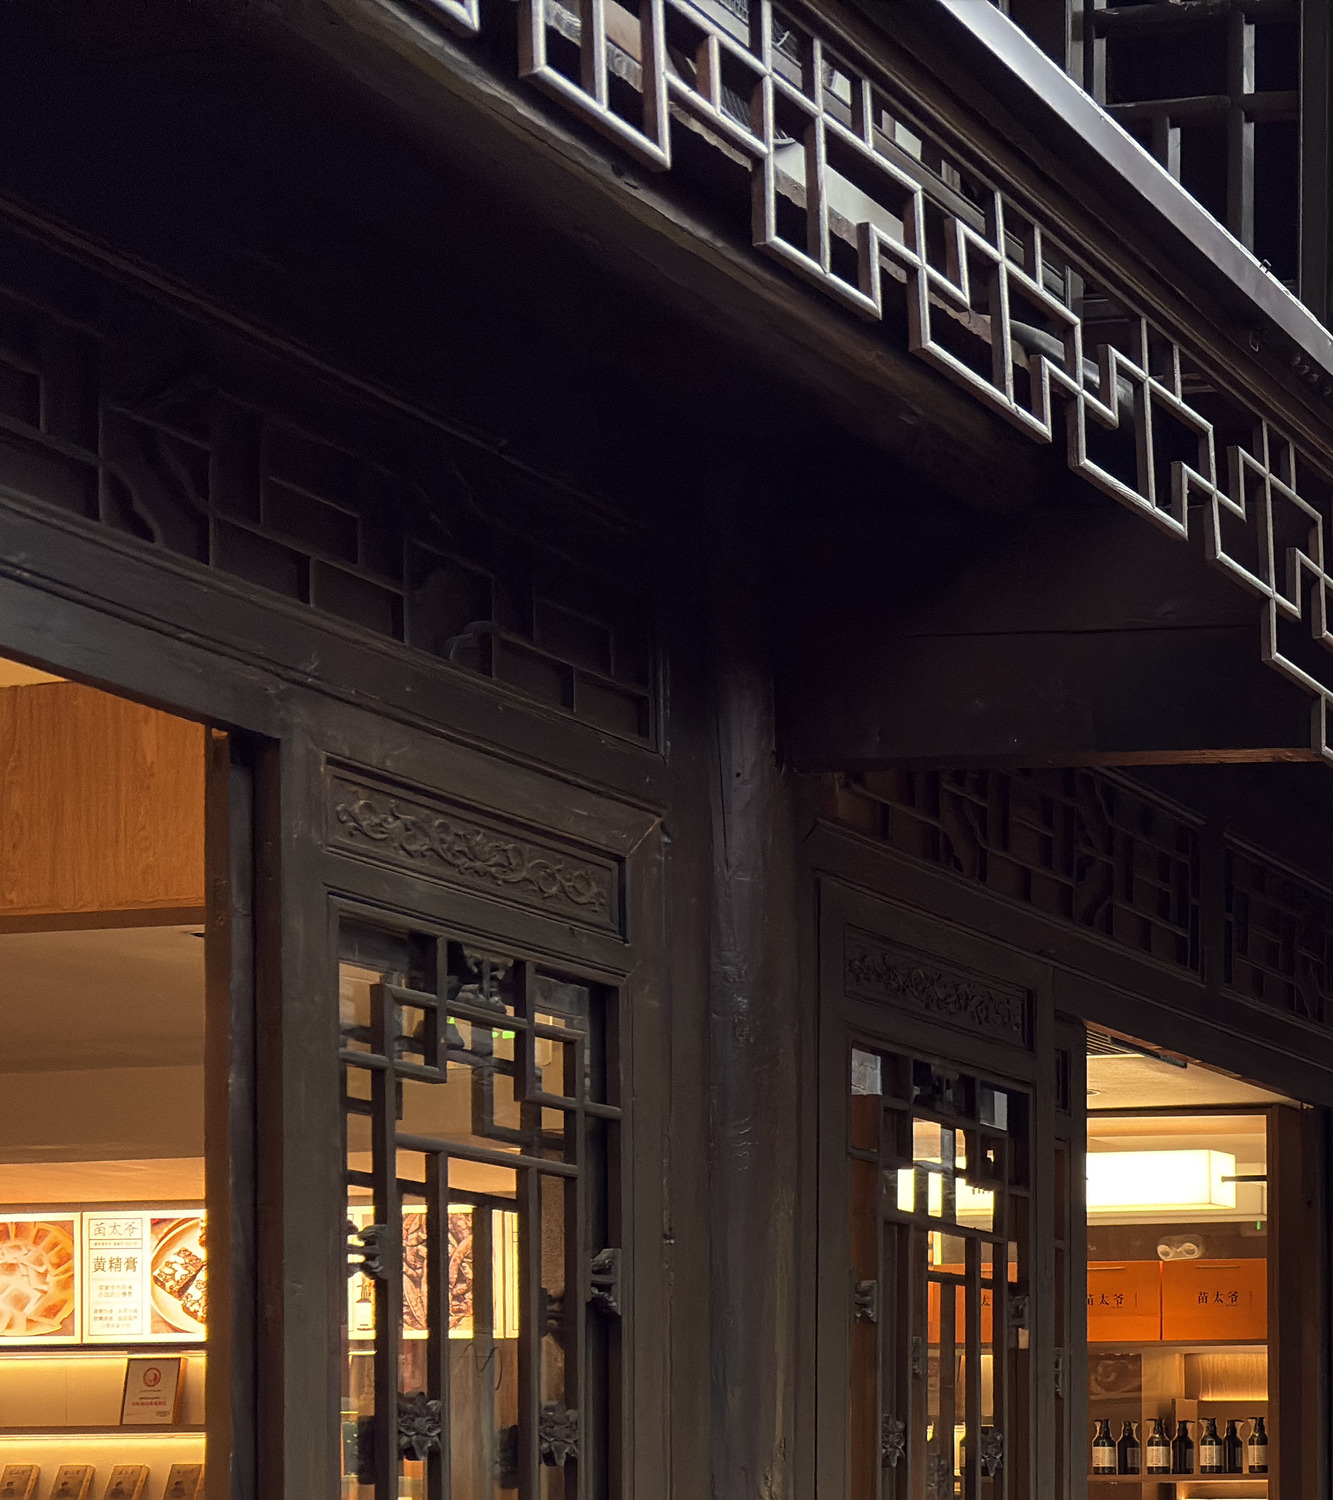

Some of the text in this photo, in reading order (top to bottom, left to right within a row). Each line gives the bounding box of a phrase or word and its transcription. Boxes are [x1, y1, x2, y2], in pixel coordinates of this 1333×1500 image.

[92, 1256, 139, 1273] 黄精膏
[1197, 1290, 1239, 1305] 苗太爷
